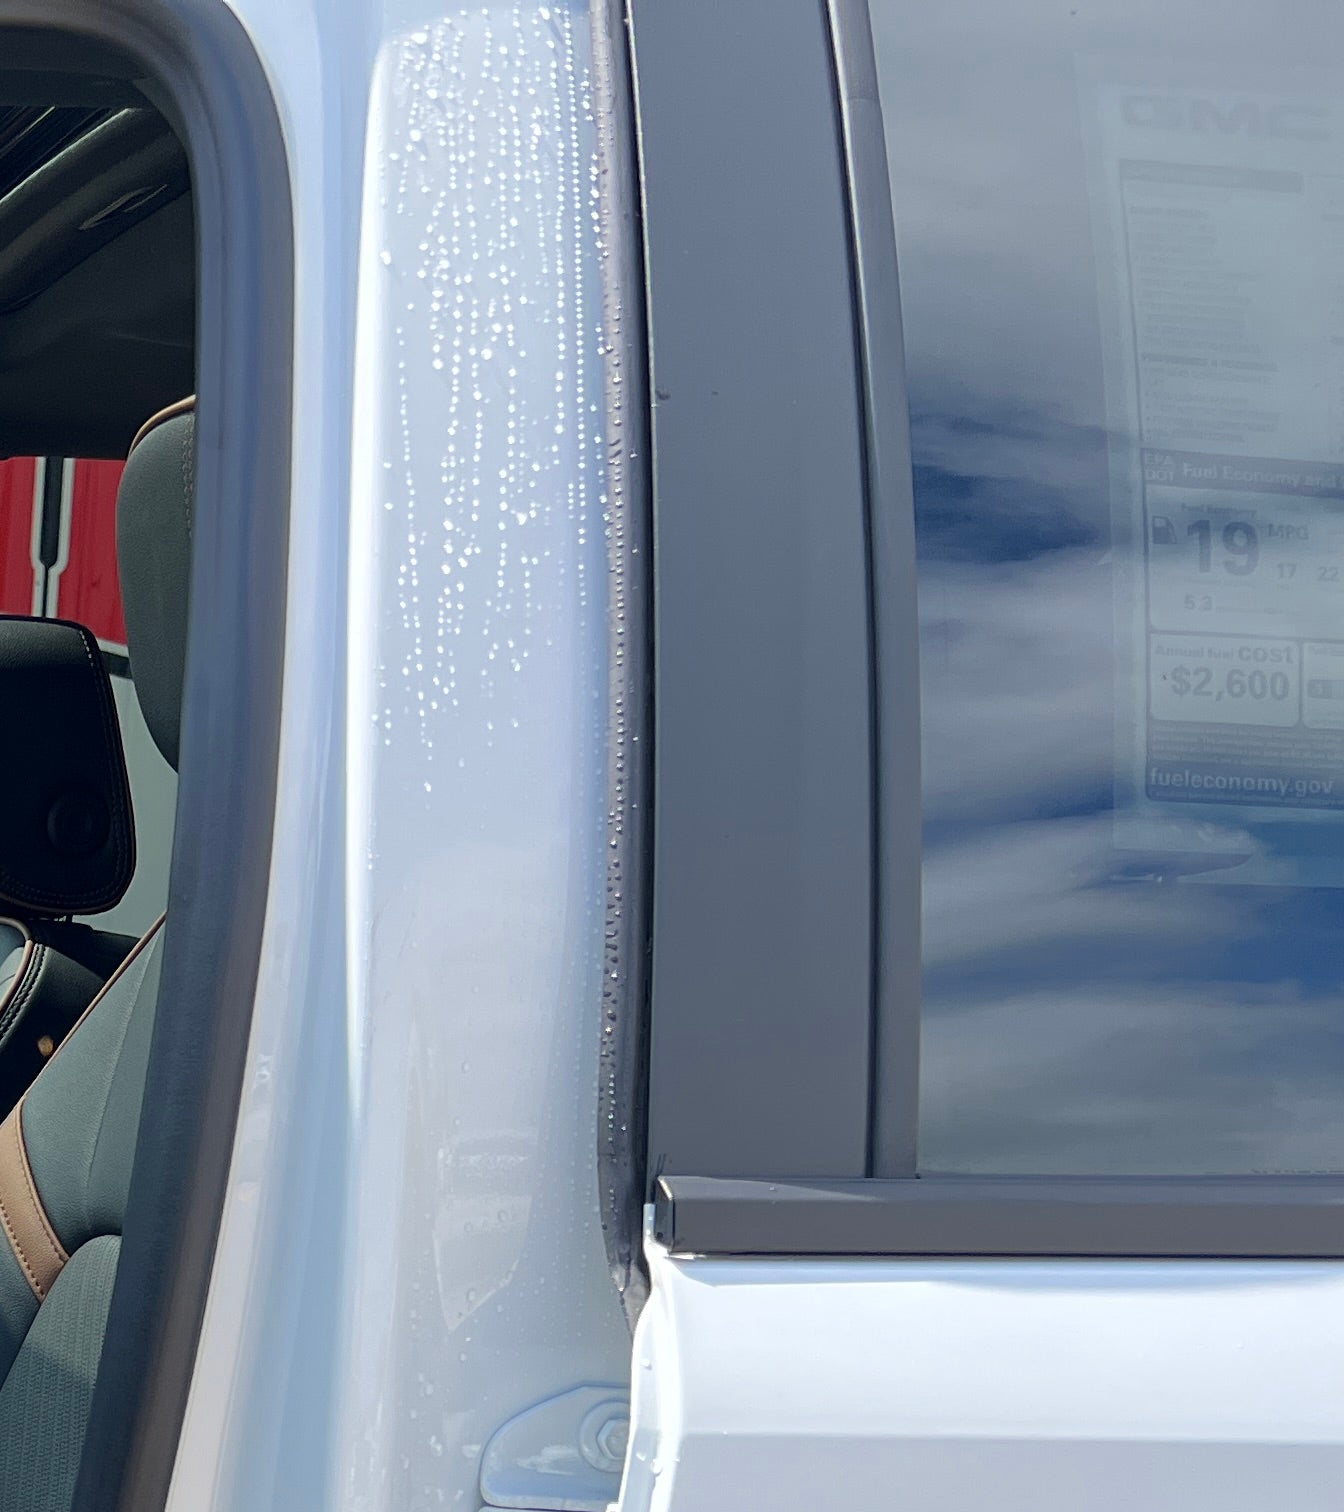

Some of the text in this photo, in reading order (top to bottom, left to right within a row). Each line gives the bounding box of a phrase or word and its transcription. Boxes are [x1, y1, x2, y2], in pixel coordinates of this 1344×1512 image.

[1183, 463, 1218, 481] Fuel
[1187, 519, 1260, 577] 19
[1277, 563, 1296, 579] 17
[1170, 664, 1290, 701] $2,600
[1149, 768, 1335, 797] fueleconomy.gov
